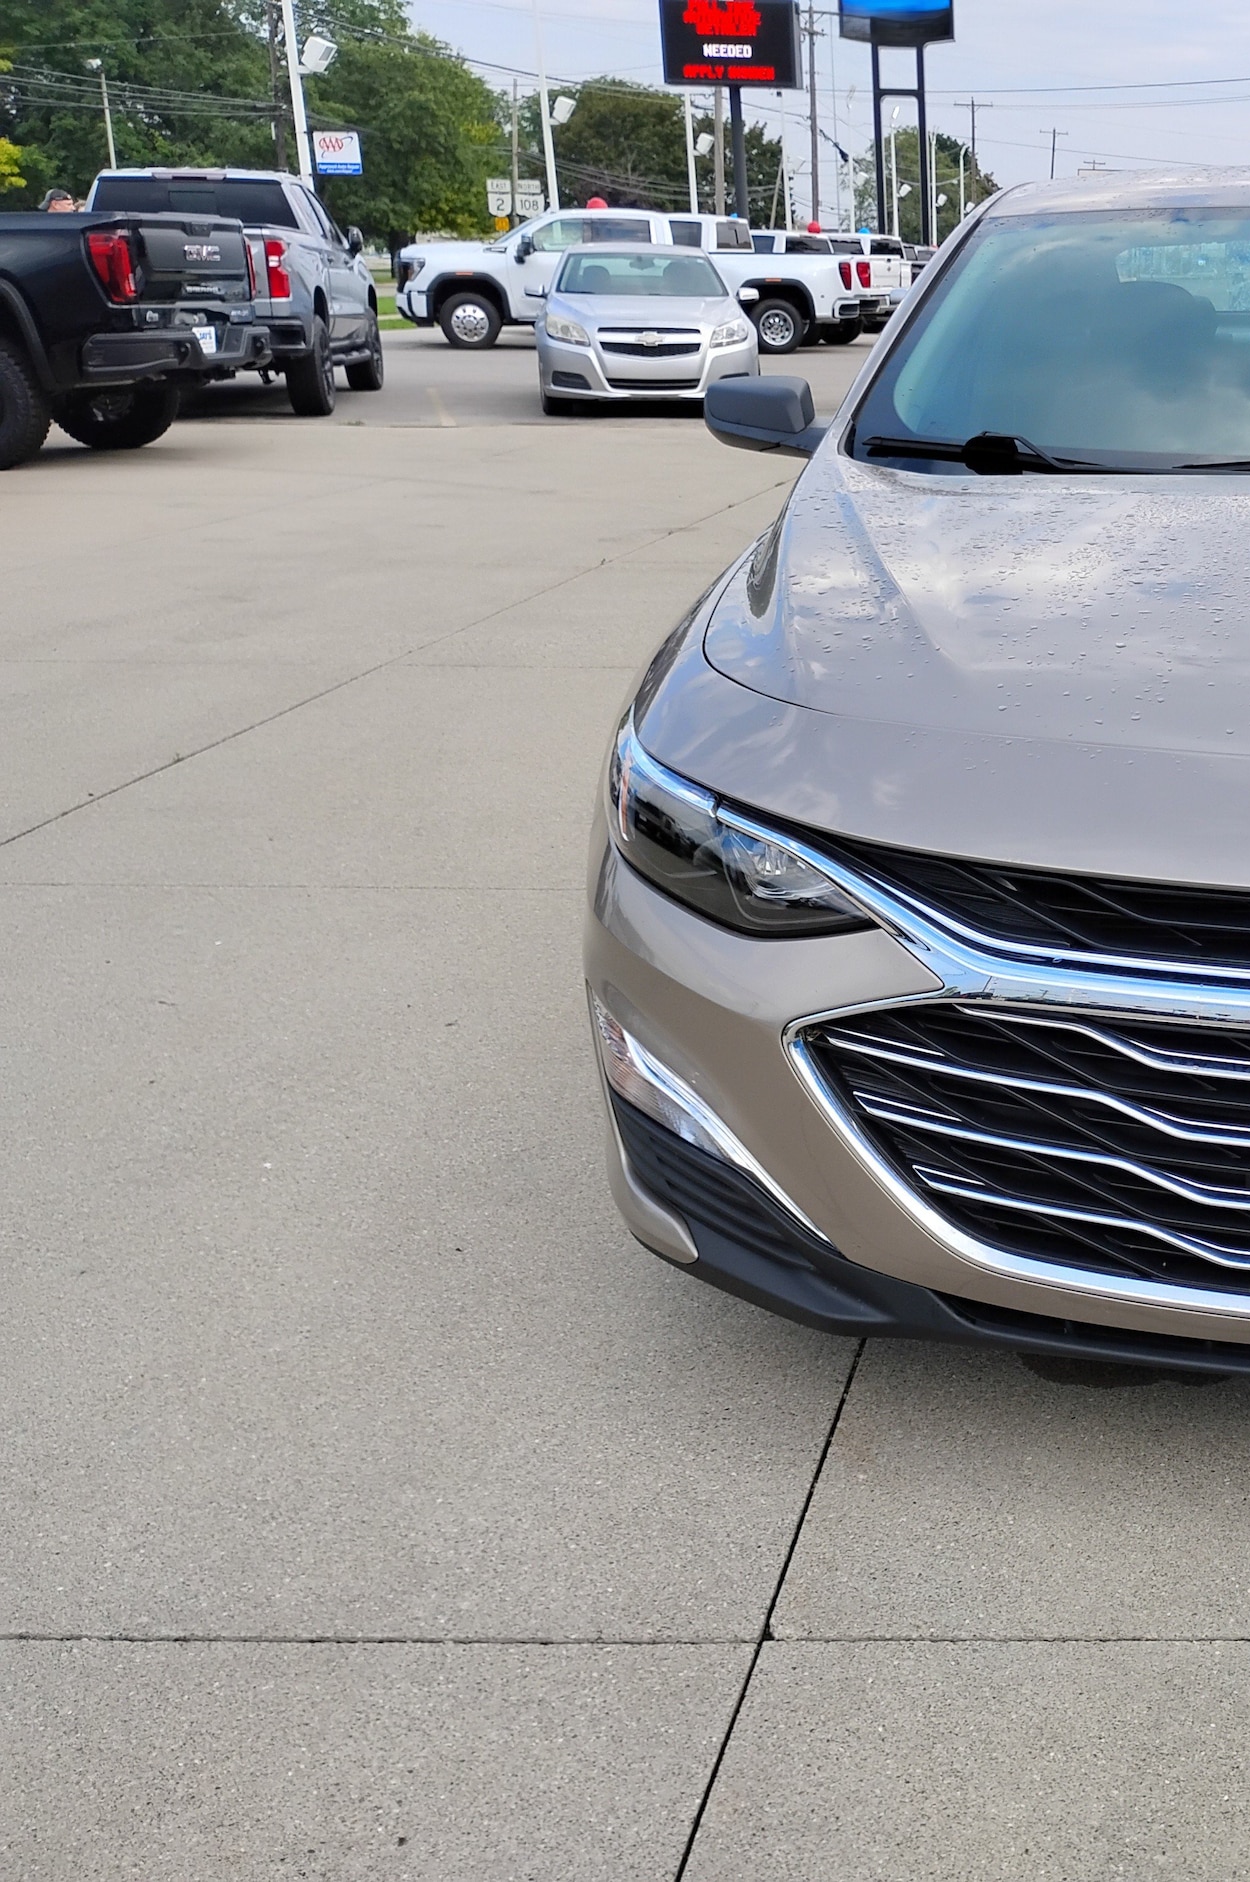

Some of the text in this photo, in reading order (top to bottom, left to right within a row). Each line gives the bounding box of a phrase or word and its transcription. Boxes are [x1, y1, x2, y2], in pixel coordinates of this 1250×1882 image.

[703, 43, 752, 58] NEEDED
[683, 64, 725, 79] APPLY
[319, 136, 344, 152] AAA
[490, 181, 507, 189] EAST
[496, 198, 505, 211] 2
[520, 199, 539, 211] 108
[184, 245, 221, 261] GMC
